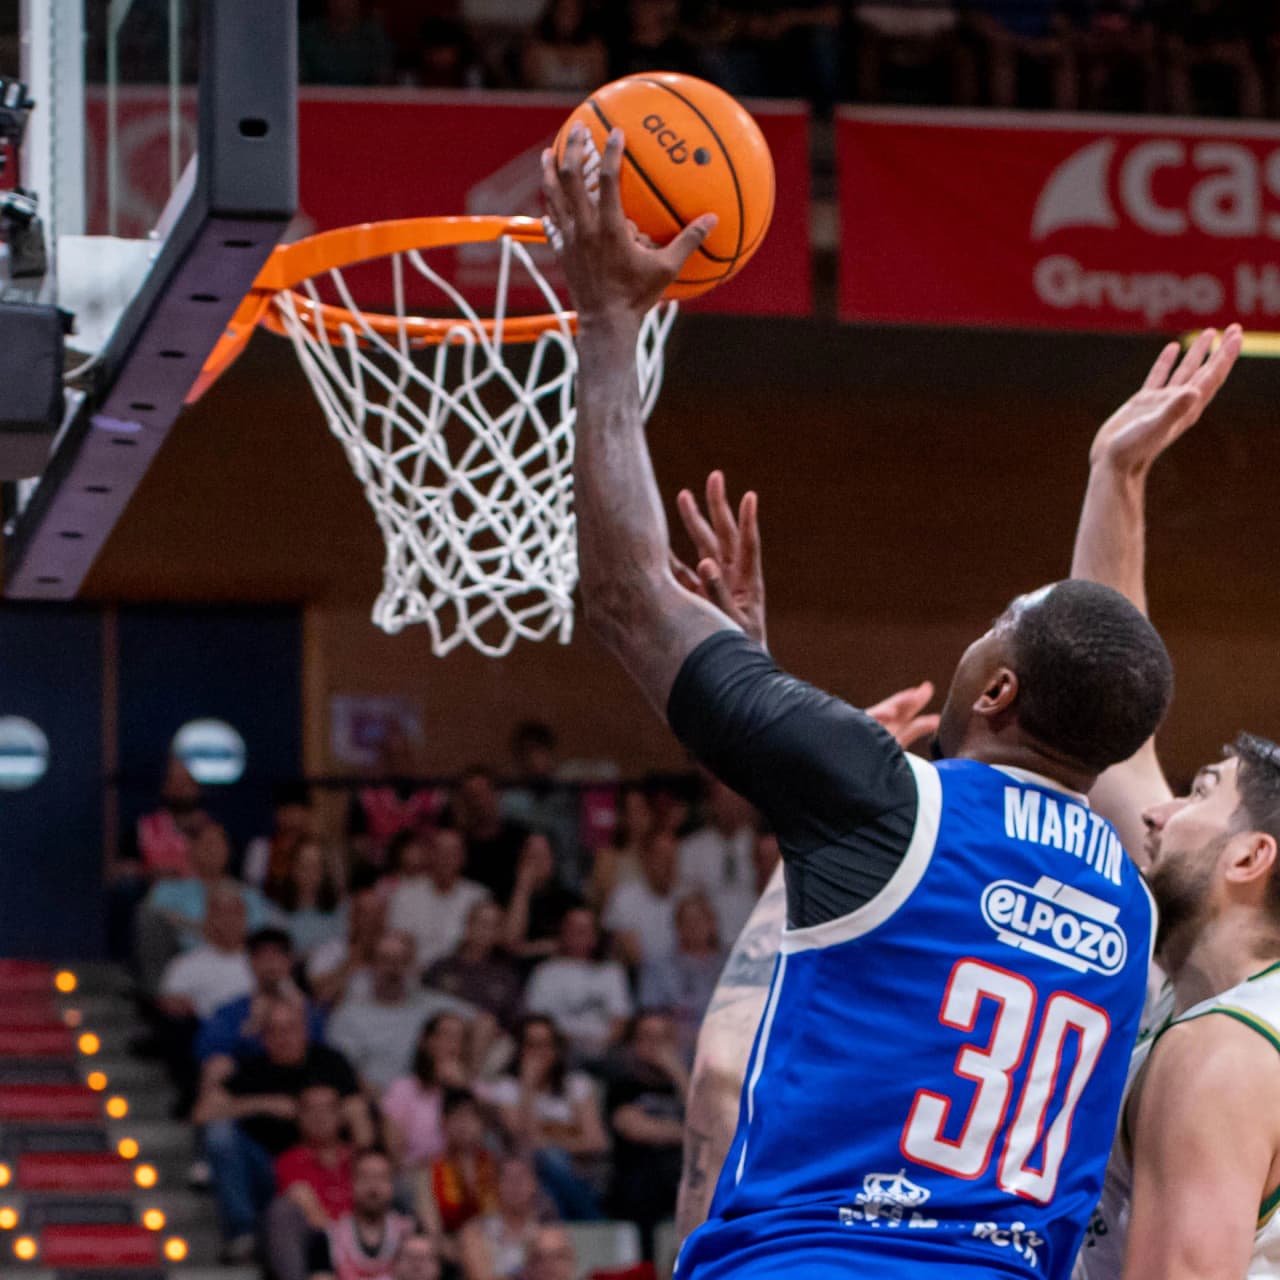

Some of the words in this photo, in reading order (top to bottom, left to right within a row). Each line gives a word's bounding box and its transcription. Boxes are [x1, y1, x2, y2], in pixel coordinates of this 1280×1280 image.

[643, 114, 688, 165] acb
[1033, 254, 1223, 325] Grupo
[1004, 786, 1122, 886] MARTIN
[900, 957, 1111, 1206] 30
